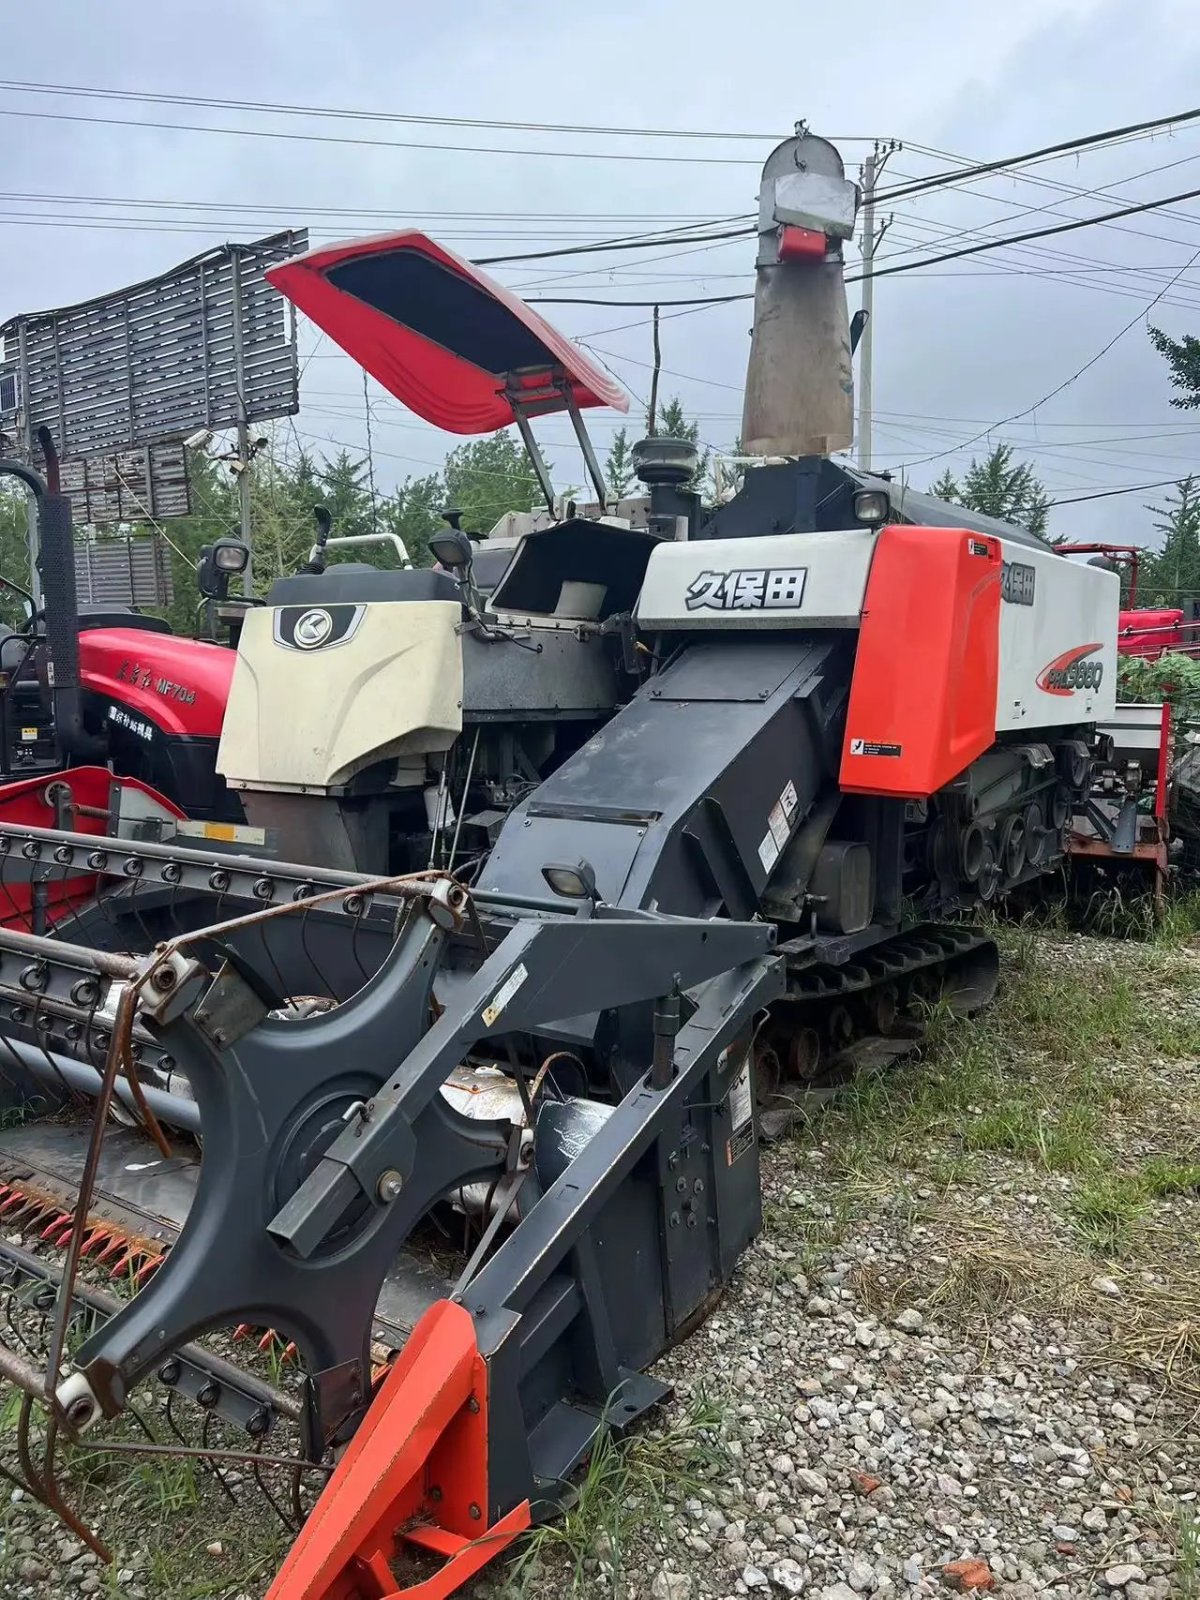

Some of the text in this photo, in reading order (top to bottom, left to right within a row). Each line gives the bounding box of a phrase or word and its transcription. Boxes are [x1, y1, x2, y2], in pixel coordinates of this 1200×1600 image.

[685, 567, 808, 611] 久保田
[155, 678, 197, 705] MF704
